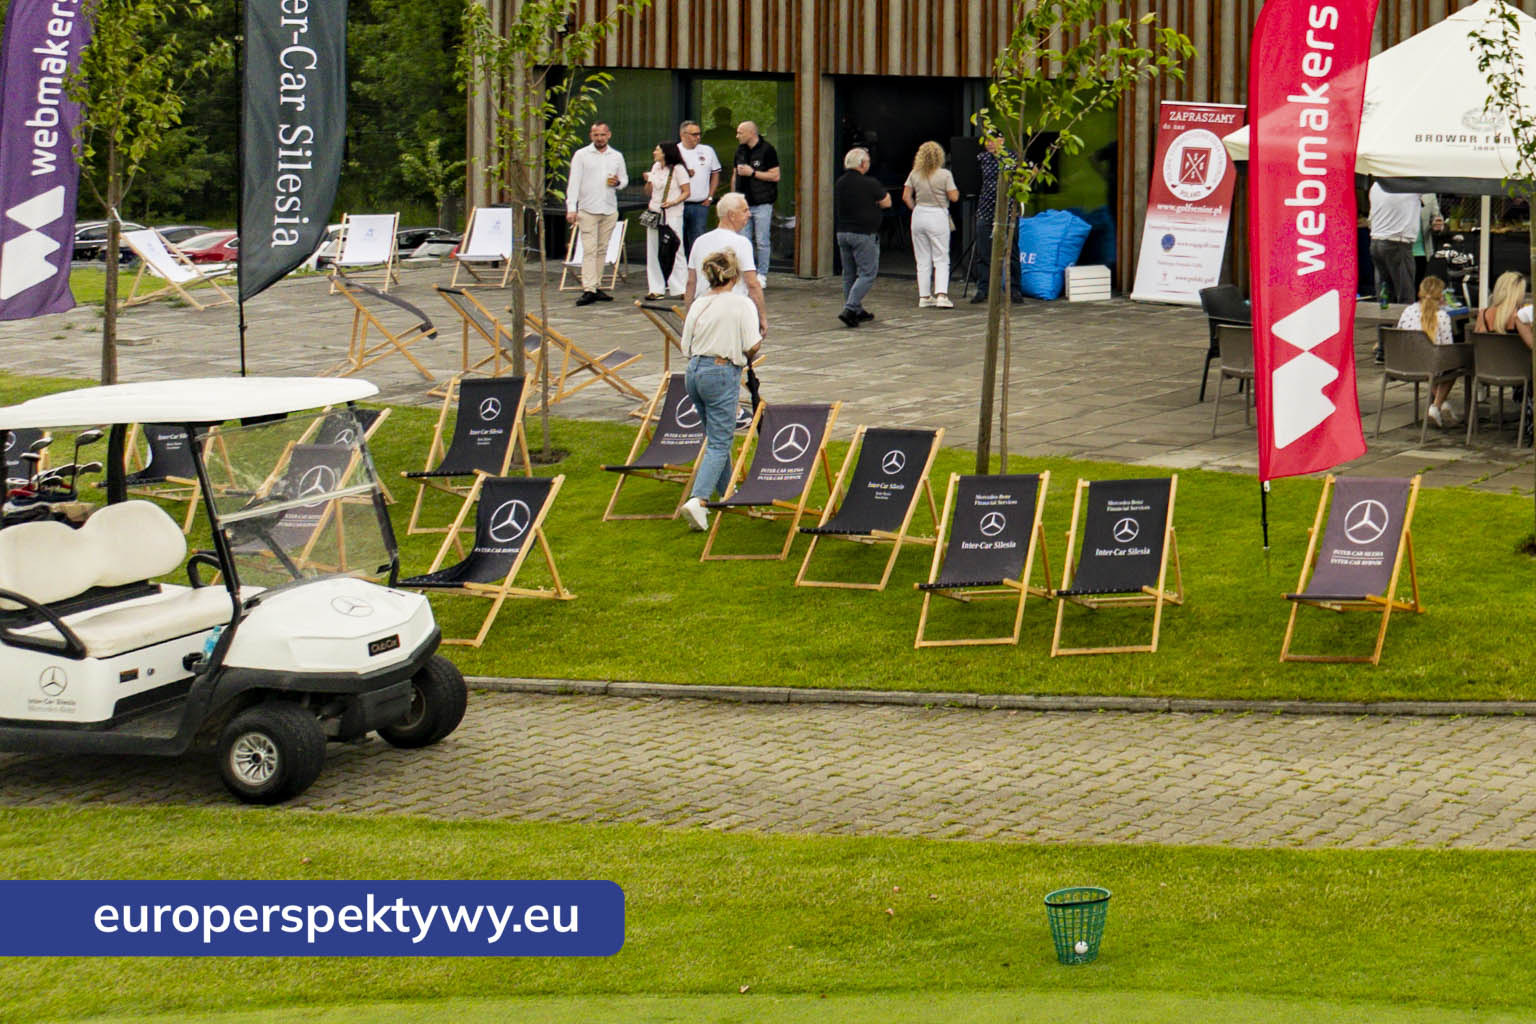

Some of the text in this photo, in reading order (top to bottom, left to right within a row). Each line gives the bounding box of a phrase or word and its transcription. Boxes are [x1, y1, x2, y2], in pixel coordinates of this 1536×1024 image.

[1169, 111, 1236, 124] ZAPRASZAMY
[1284, 5, 1339, 276] webmakers
[1414, 134, 1478, 144] BROWAR
[271, 124, 314, 248] Silesia
[961, 541, 1017, 550] Inter-Car Silesia
[1095, 547, 1151, 557] Inter-Car Silesia
